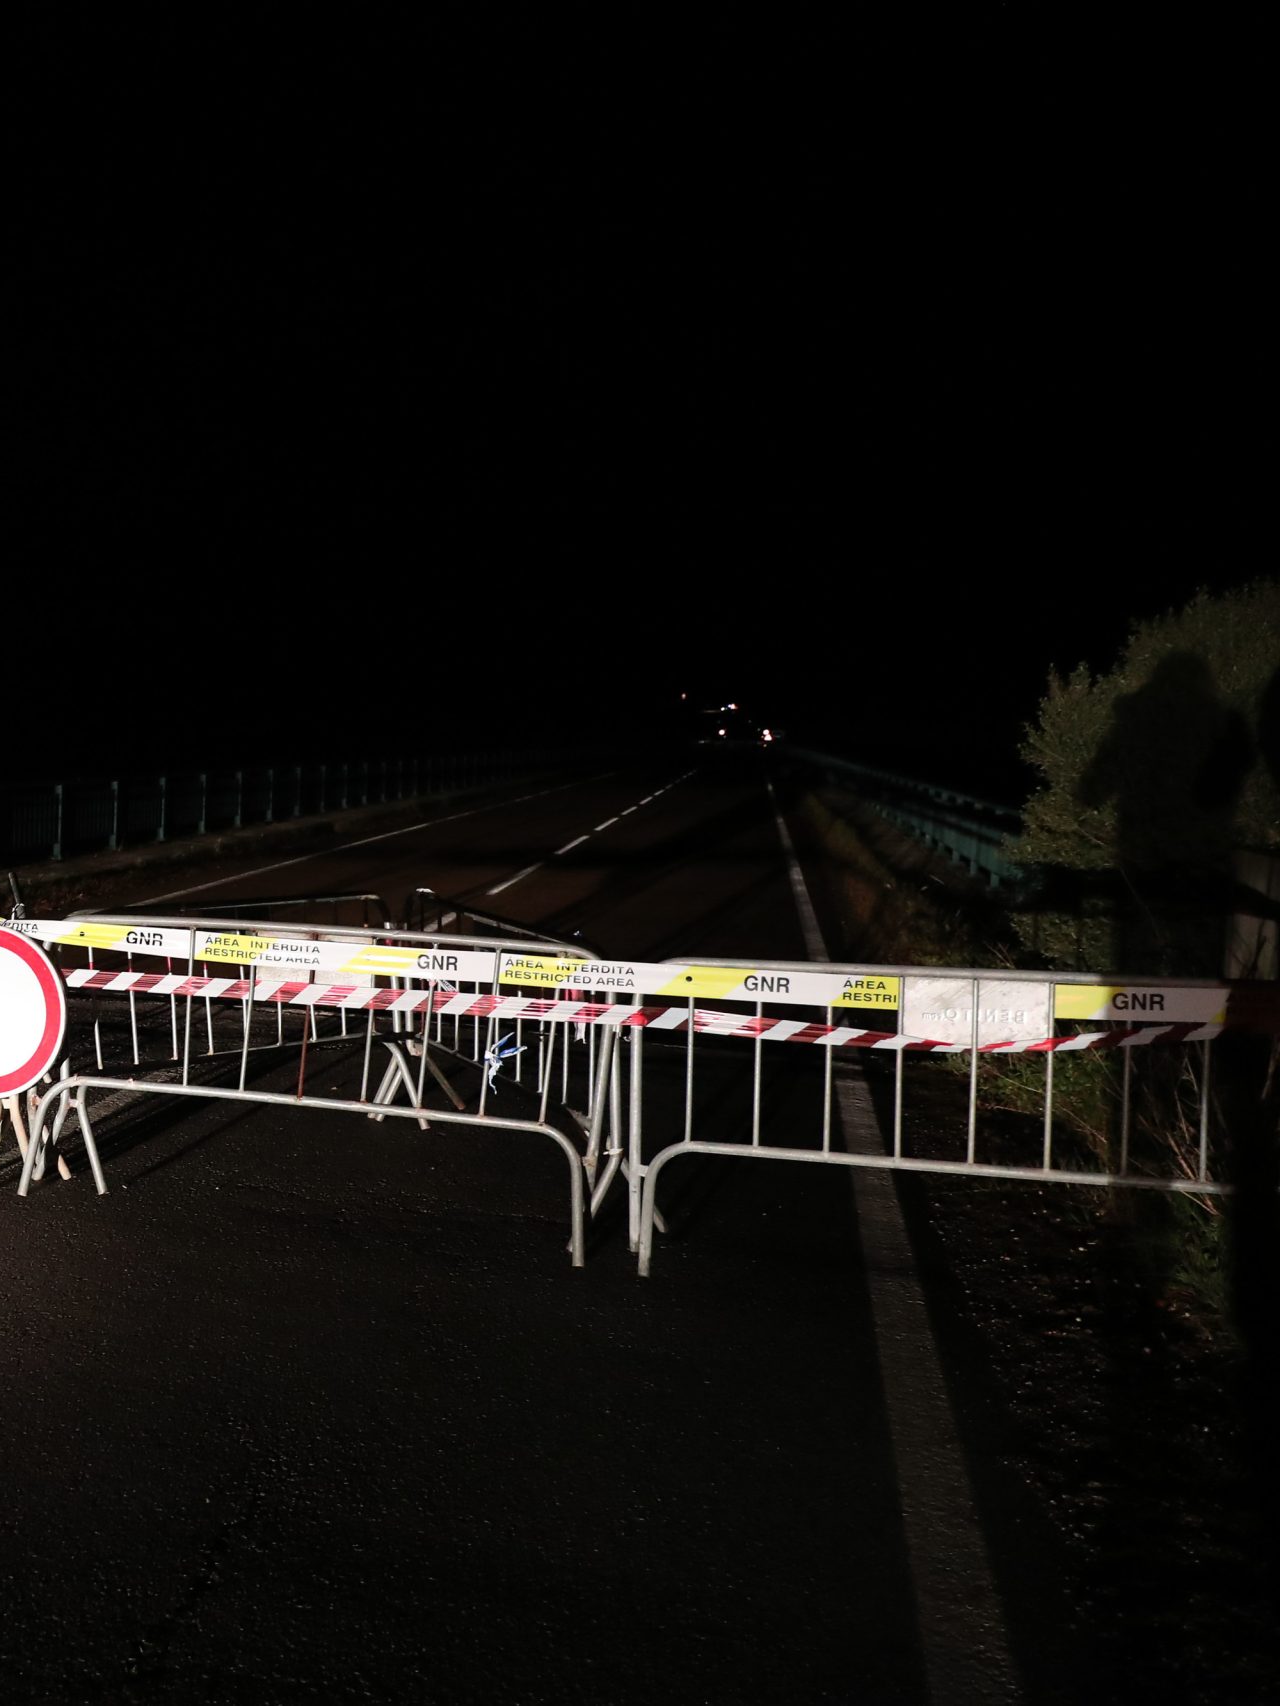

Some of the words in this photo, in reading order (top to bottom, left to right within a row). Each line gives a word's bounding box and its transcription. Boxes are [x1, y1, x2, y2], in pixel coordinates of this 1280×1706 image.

[126, 931, 163, 947] GNR
[250, 940, 320, 953] INTERDITA
[205, 947, 282, 962] RESTRICTED
[417, 954, 458, 972] GNR
[556, 962, 635, 976] INTERDITA
[505, 970, 591, 985] RESTRICTED
[596, 977, 635, 988] AREA
[744, 975, 790, 993] GNR
[843, 977, 886, 990] ÁREA
[842, 992, 897, 1003] RESTRI
[1112, 993, 1165, 1011] GNR
